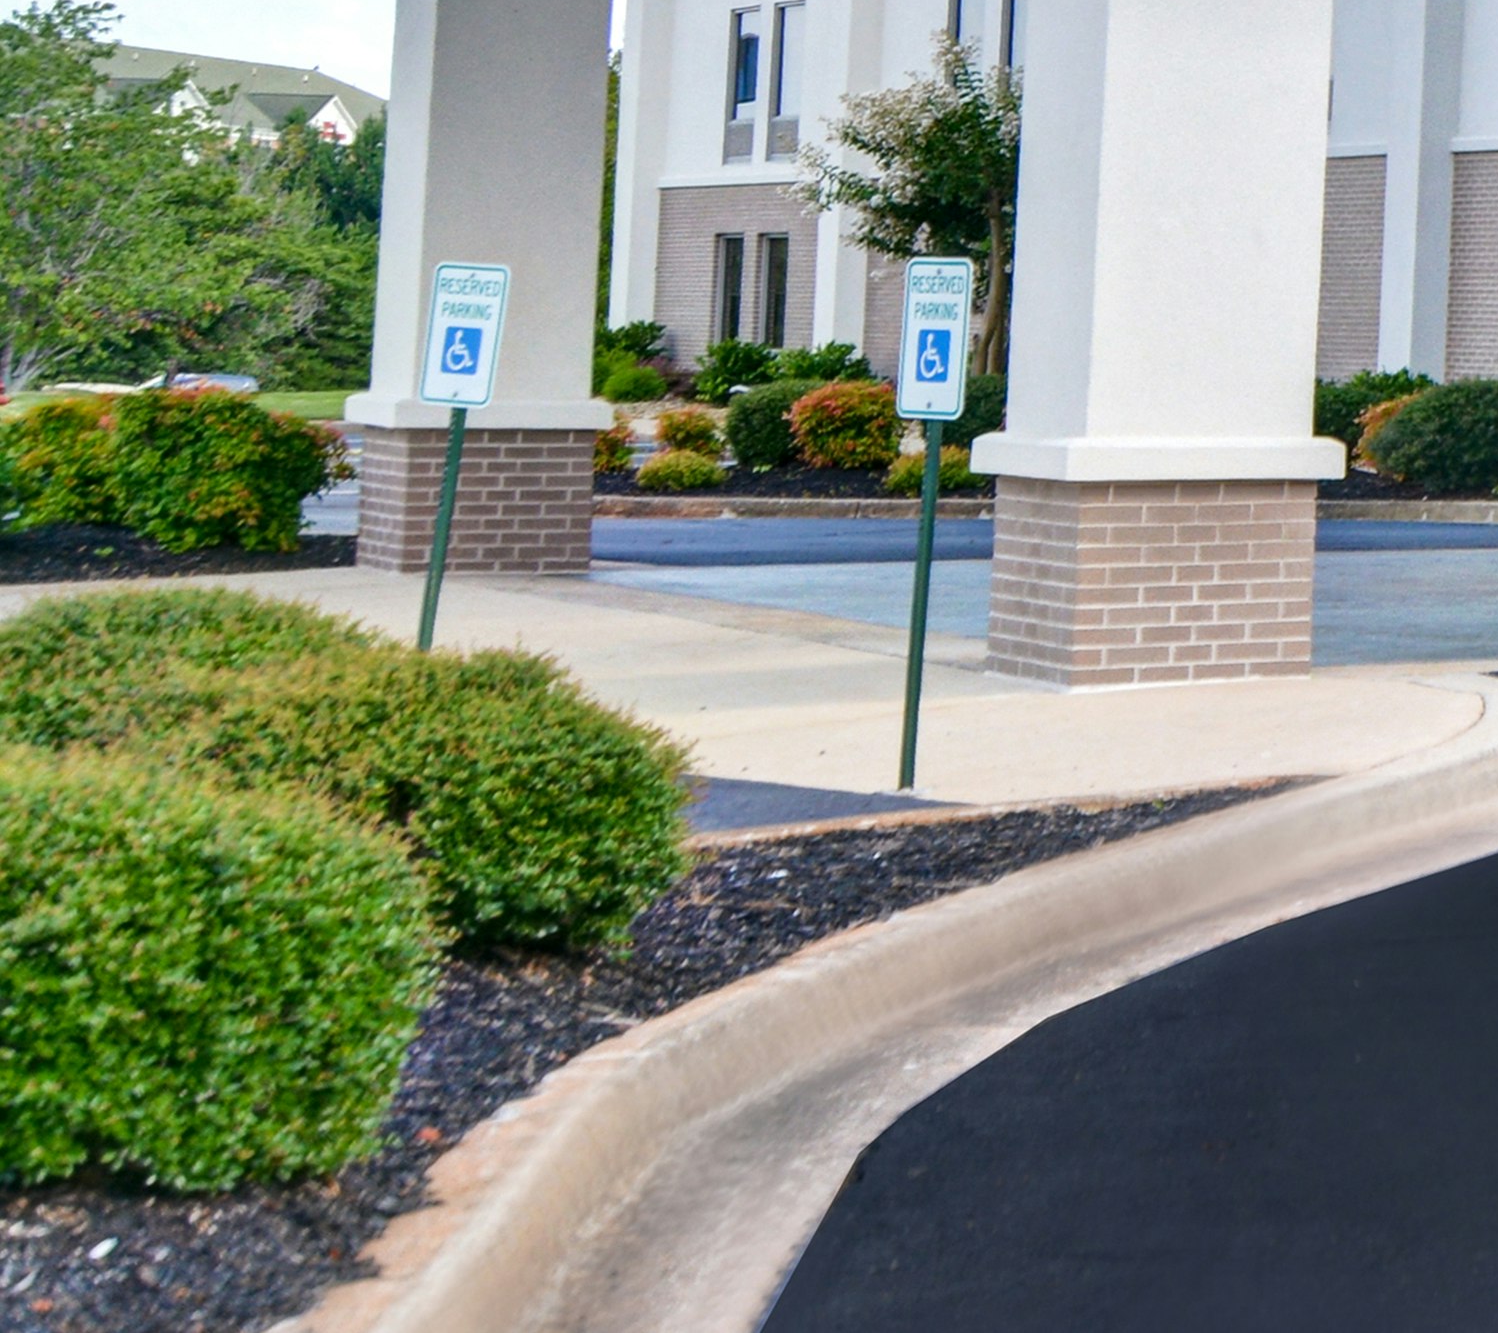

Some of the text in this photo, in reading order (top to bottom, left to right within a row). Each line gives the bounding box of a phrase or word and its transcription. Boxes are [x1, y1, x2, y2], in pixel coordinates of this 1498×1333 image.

[440, 277, 500, 297] RESERVED
[911, 275, 964, 294] RESERVED
[441, 301, 492, 320] PARKING
[914, 302, 958, 320] PARKING
